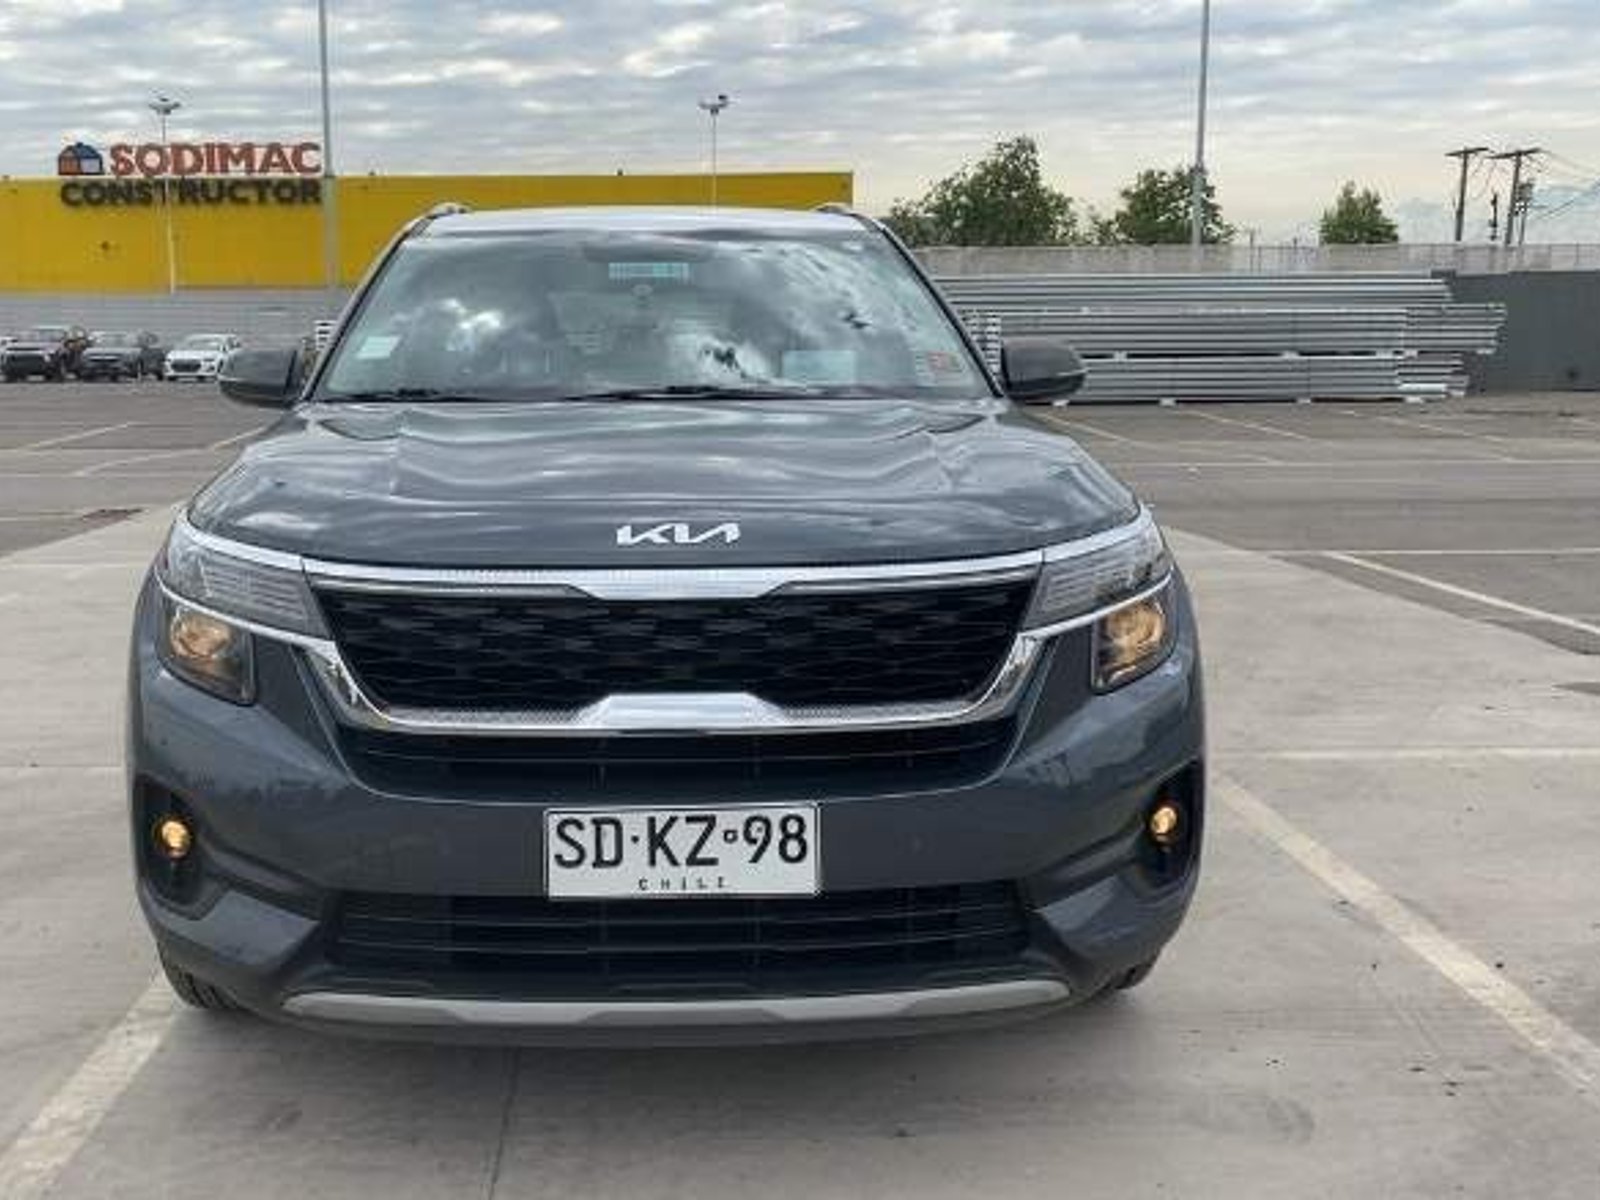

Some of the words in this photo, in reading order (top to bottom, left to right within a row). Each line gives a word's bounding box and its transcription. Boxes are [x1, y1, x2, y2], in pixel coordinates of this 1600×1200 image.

[110, 142, 321, 175] SODIMAC
[60, 179, 321, 206] CONSTRUCTOR
[616, 522, 740, 544] KIA
